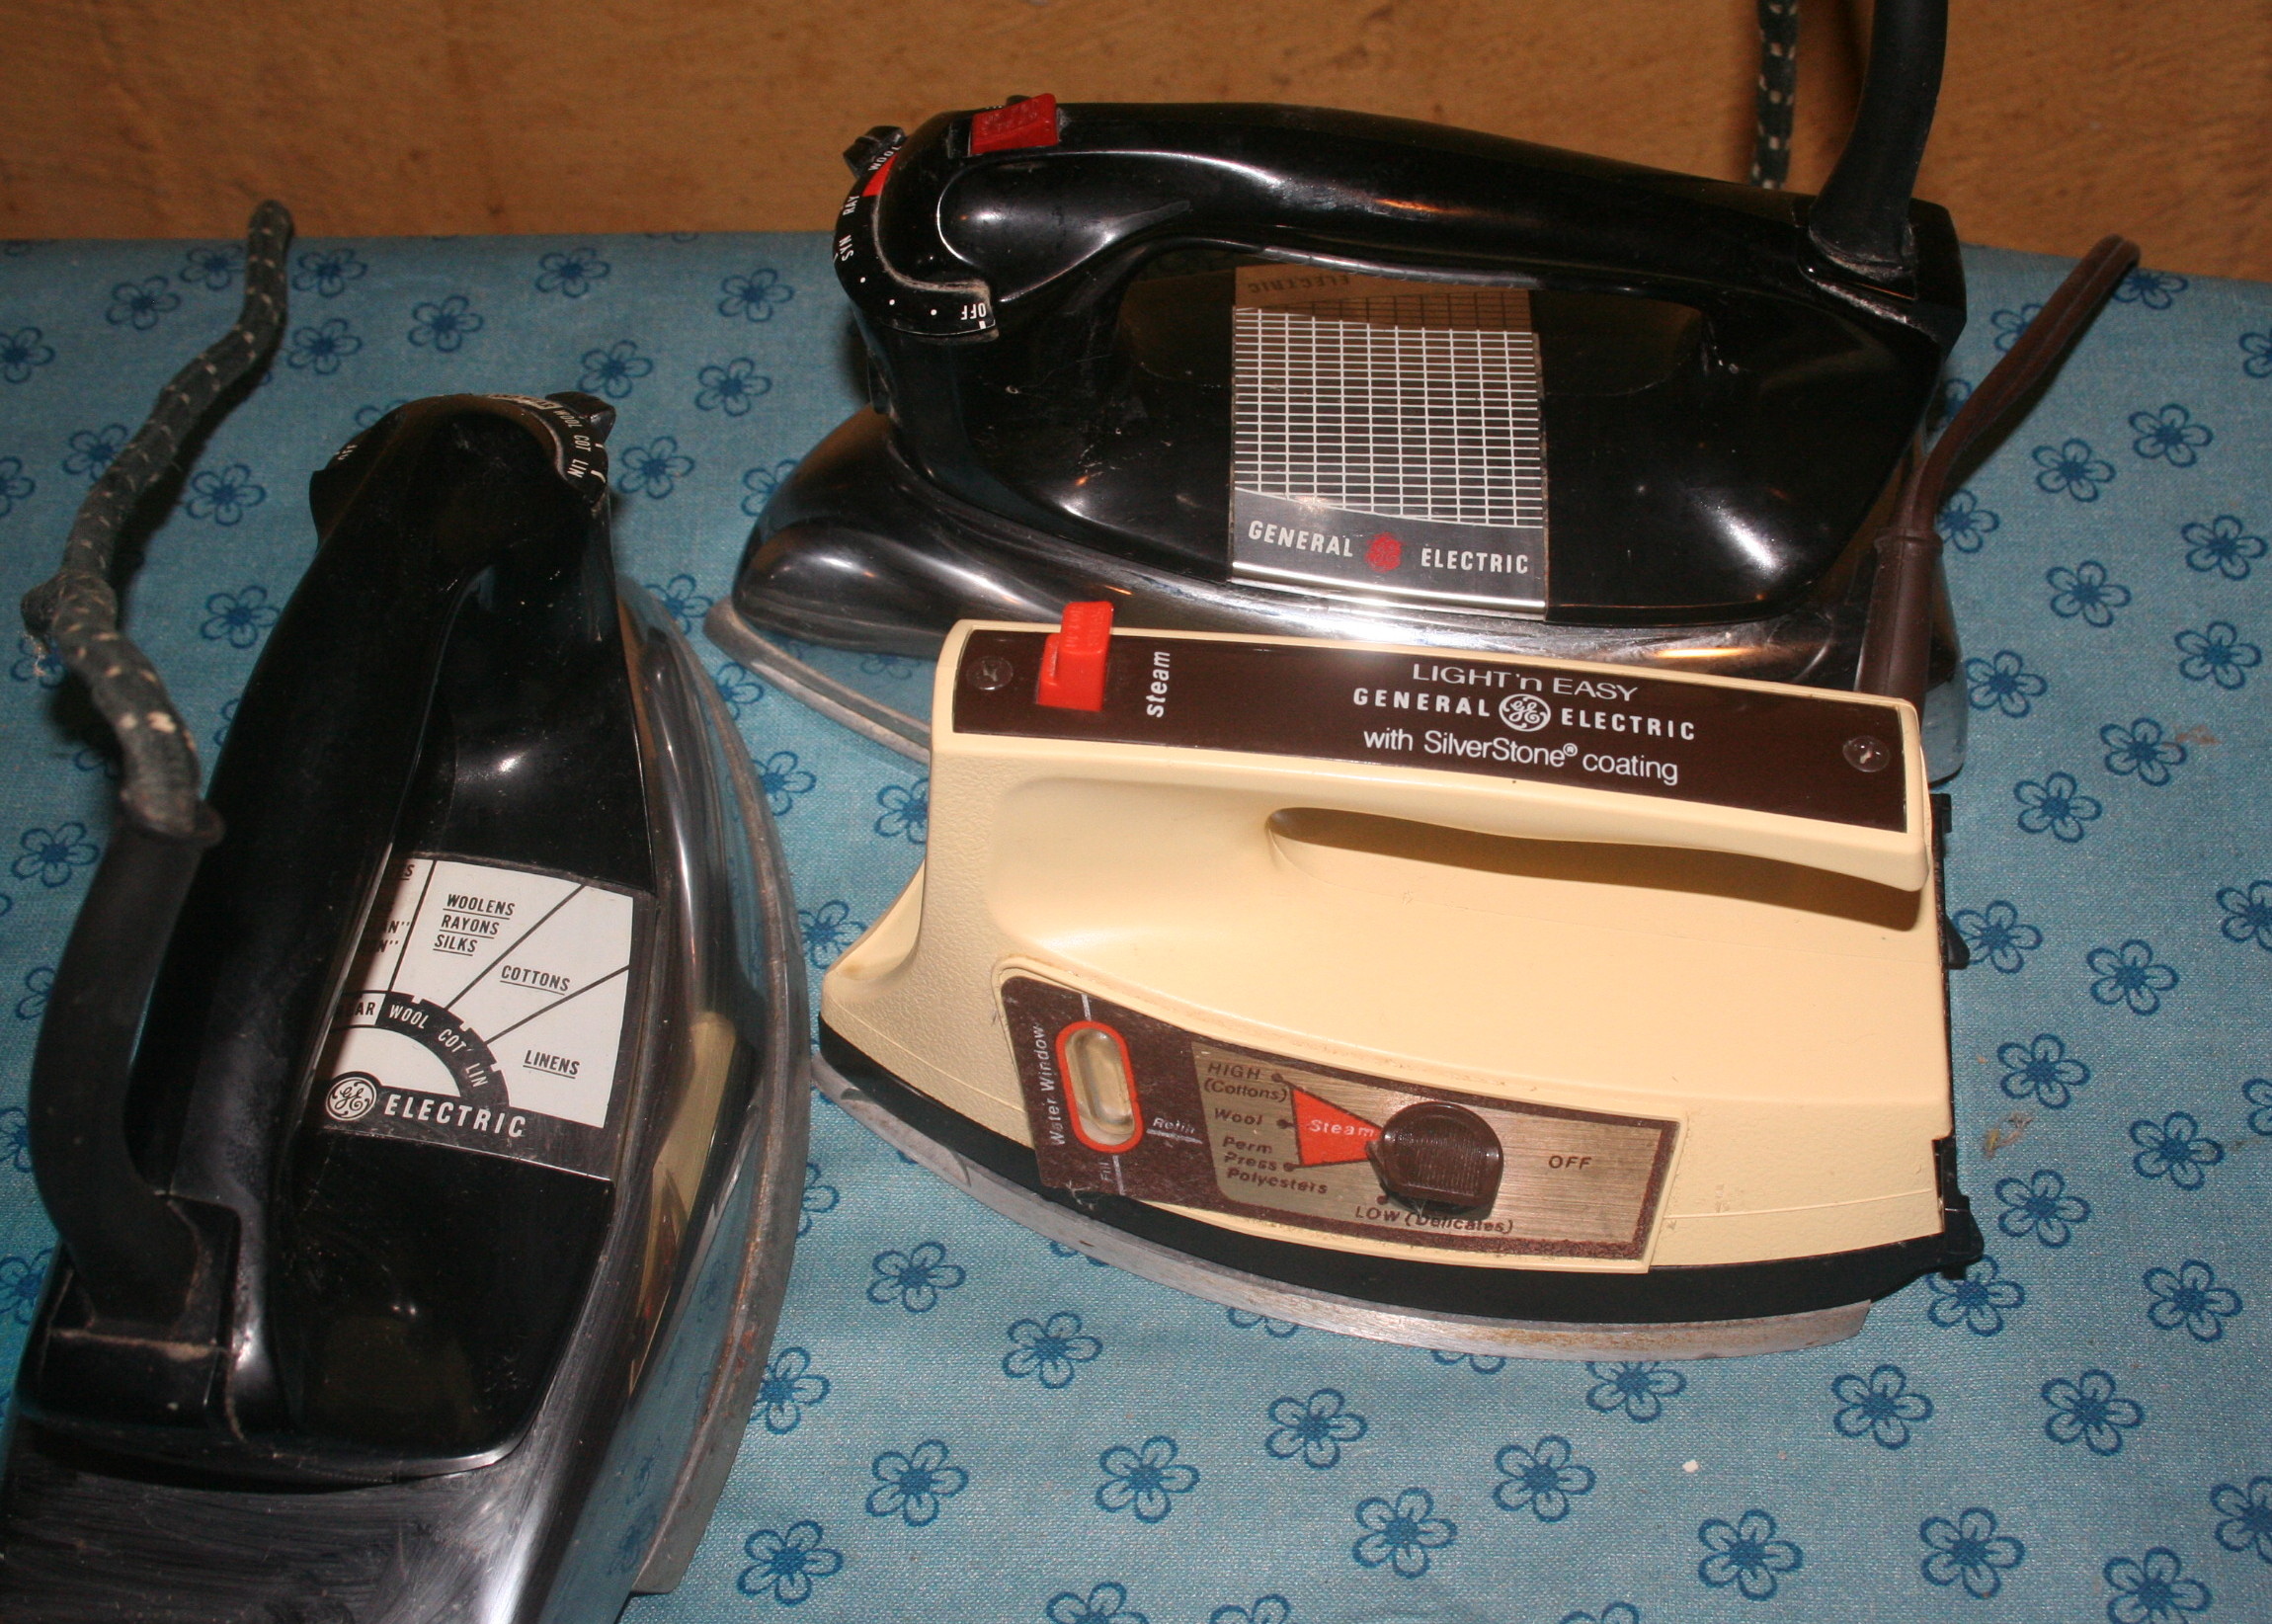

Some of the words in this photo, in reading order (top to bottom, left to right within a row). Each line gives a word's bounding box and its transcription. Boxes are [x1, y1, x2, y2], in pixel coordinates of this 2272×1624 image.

[843, 196, 860, 216] RAY
[839, 234, 854, 262] SYN
[960, 302, 987, 320] OFF
[573, 435, 592, 452] COT
[567, 458, 590, 479] LIN
[1248, 520, 1353, 557] GENERAL
[1420, 546, 1529, 574] ELECTRIC
[1146, 651, 1171, 718] steam
[1413, 663, 1511, 689] LIGHT
[1553, 677, 1639, 701] EASY
[1353, 688, 1491, 717] GENERAL
[1561, 707, 1695, 741] ELECTRIC
[1363, 727, 1414, 752] with
[1582, 754, 1678, 786] coating
[446, 893, 515, 917] WOOLENS
[442, 915, 500, 935] RAYONS
[434, 934, 477, 953] SILKS
[501, 965, 571, 992] COTTONS
[388, 1003, 430, 1029] WOOL
[465, 1062, 488, 1088] LIN
[1033, 1023, 1055, 1092] Window
[524, 1050, 581, 1075] LINENS
[1207, 1063, 1261, 1081] HIGH
[1203, 1078, 1288, 1102] (Cottons)
[384, 1095, 527, 1138] ELECTRIC
[1040, 1096, 1066, 1146] Water
[1215, 1108, 1263, 1126] Wool
[1309, 1119, 1375, 1137] Steam
[1223, 1137, 1273, 1155] Perm
[1225, 1152, 1278, 1172] Press
[1548, 1155, 1592, 1171] OFF
[1227, 1168, 1329, 1195] Polyesters
[1355, 1206, 1401, 1223] LOW
